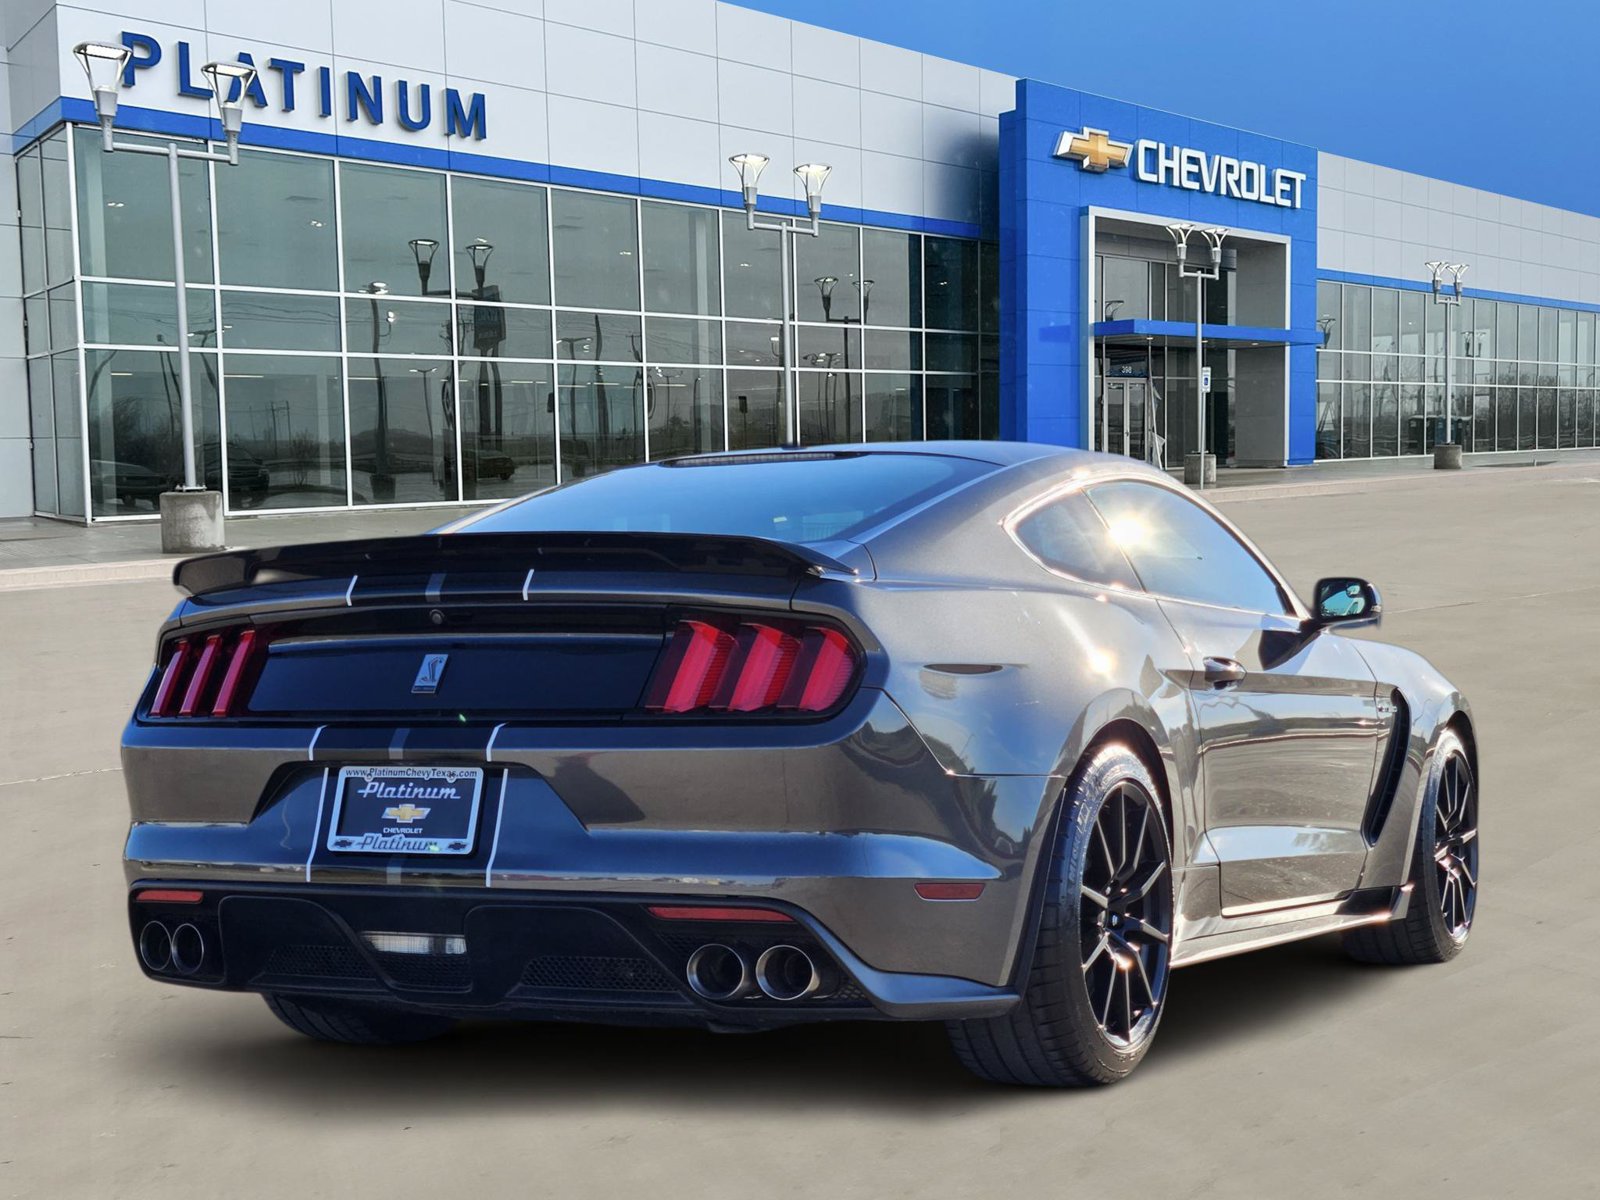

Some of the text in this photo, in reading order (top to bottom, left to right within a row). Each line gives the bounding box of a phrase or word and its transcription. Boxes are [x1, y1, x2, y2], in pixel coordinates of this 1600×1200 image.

[120, 31, 486, 141] PLATINUM
[1136, 139, 1306, 209] CHEVROLET
[358, 782, 461, 799] Platinum
